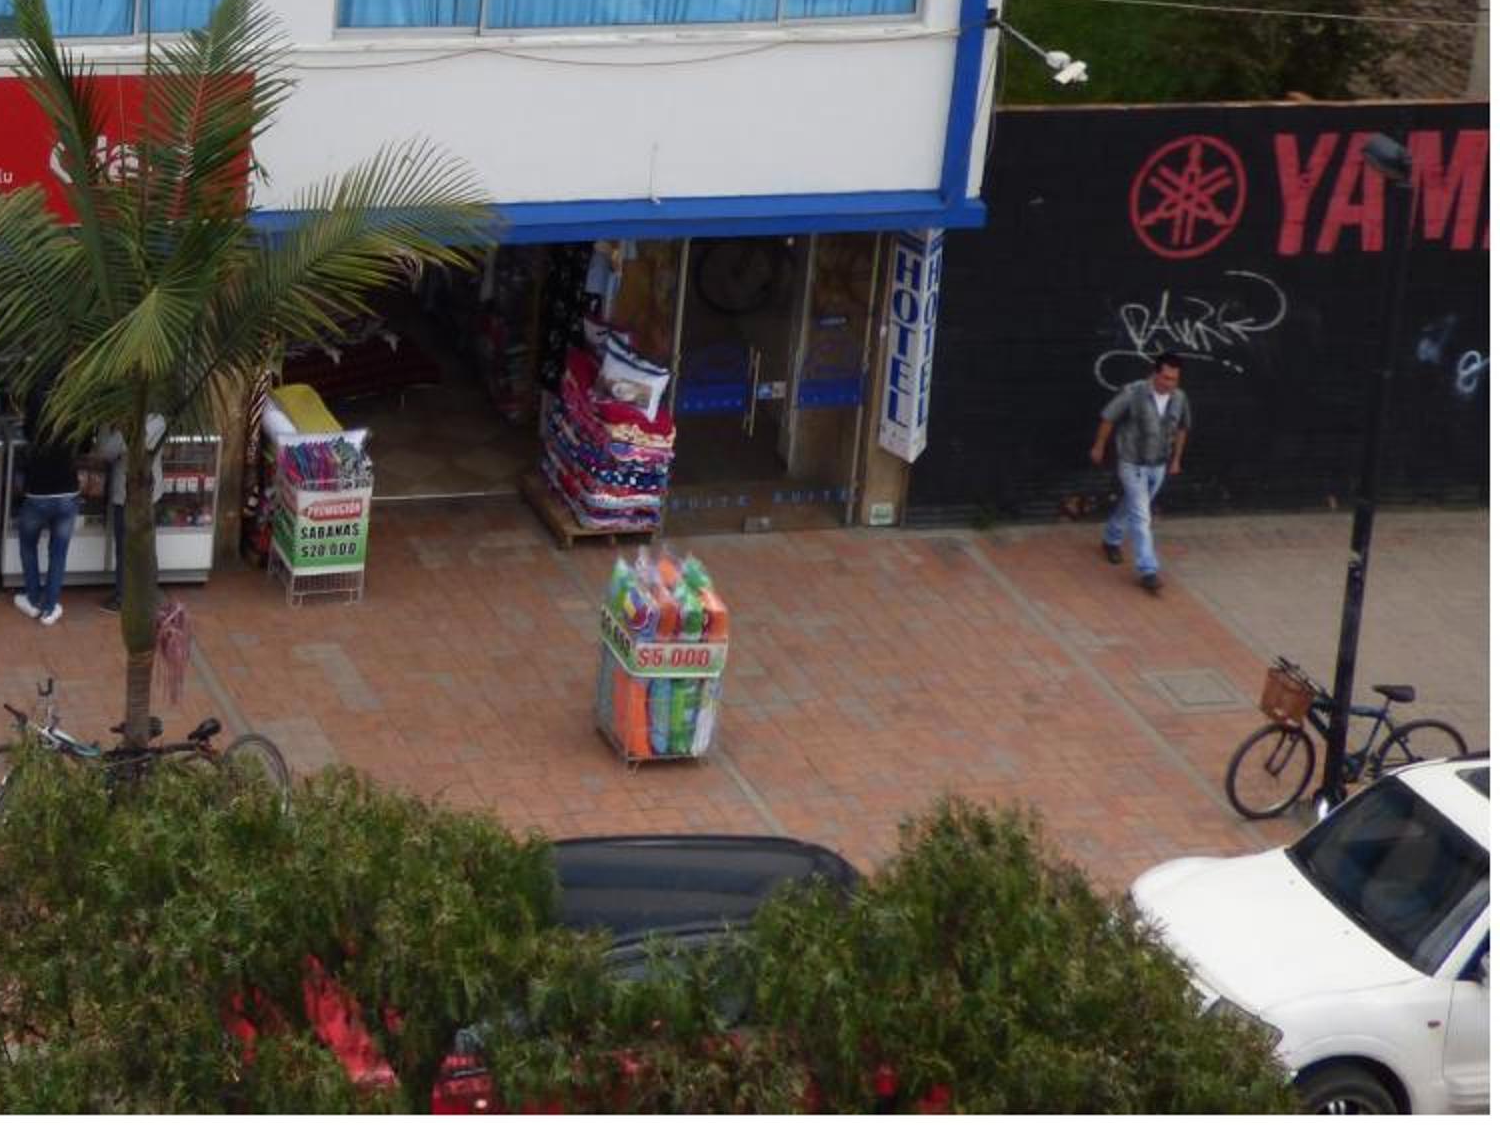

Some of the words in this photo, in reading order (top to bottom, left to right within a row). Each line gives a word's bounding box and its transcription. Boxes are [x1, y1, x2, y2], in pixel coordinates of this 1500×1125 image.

[1274, 129, 1490, 256] YAM
[887, 249, 921, 428] HOTEL
[917, 253, 943, 427] HOTEL
